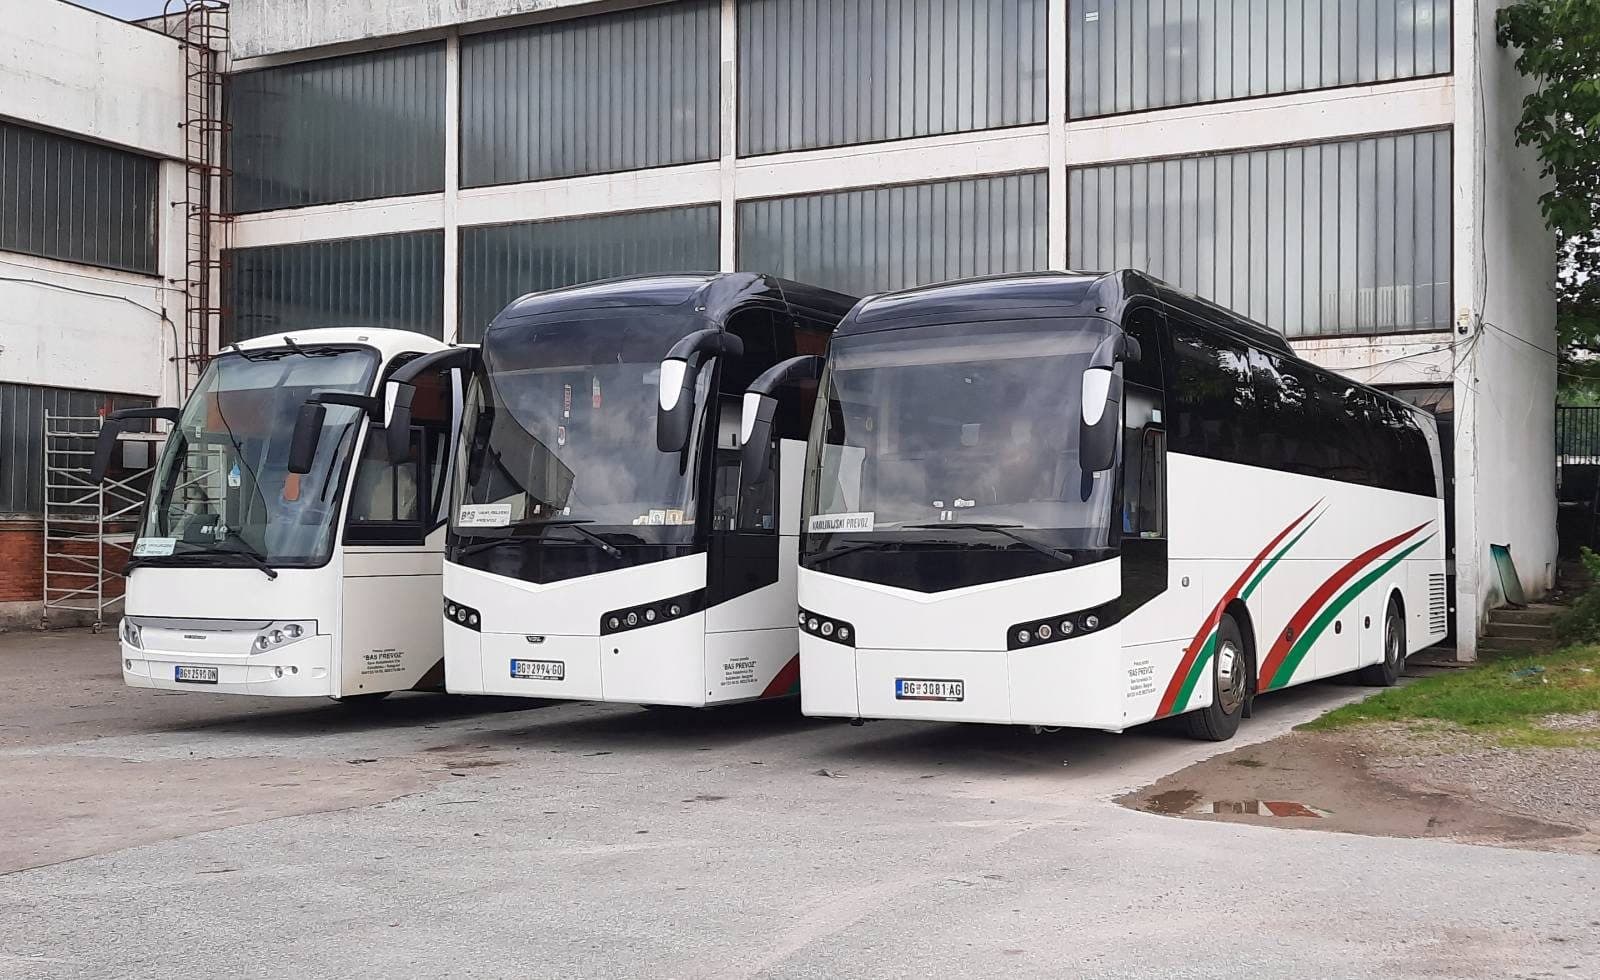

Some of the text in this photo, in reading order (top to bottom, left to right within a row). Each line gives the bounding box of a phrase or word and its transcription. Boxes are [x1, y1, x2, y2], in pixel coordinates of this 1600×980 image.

[846, 517, 869, 529] PREVOZ
[179, 667, 188, 679] BG
[517, 662, 526, 674] BG
[531, 663, 550, 675] 2994
[903, 682, 961, 696] BG 3081 AG
